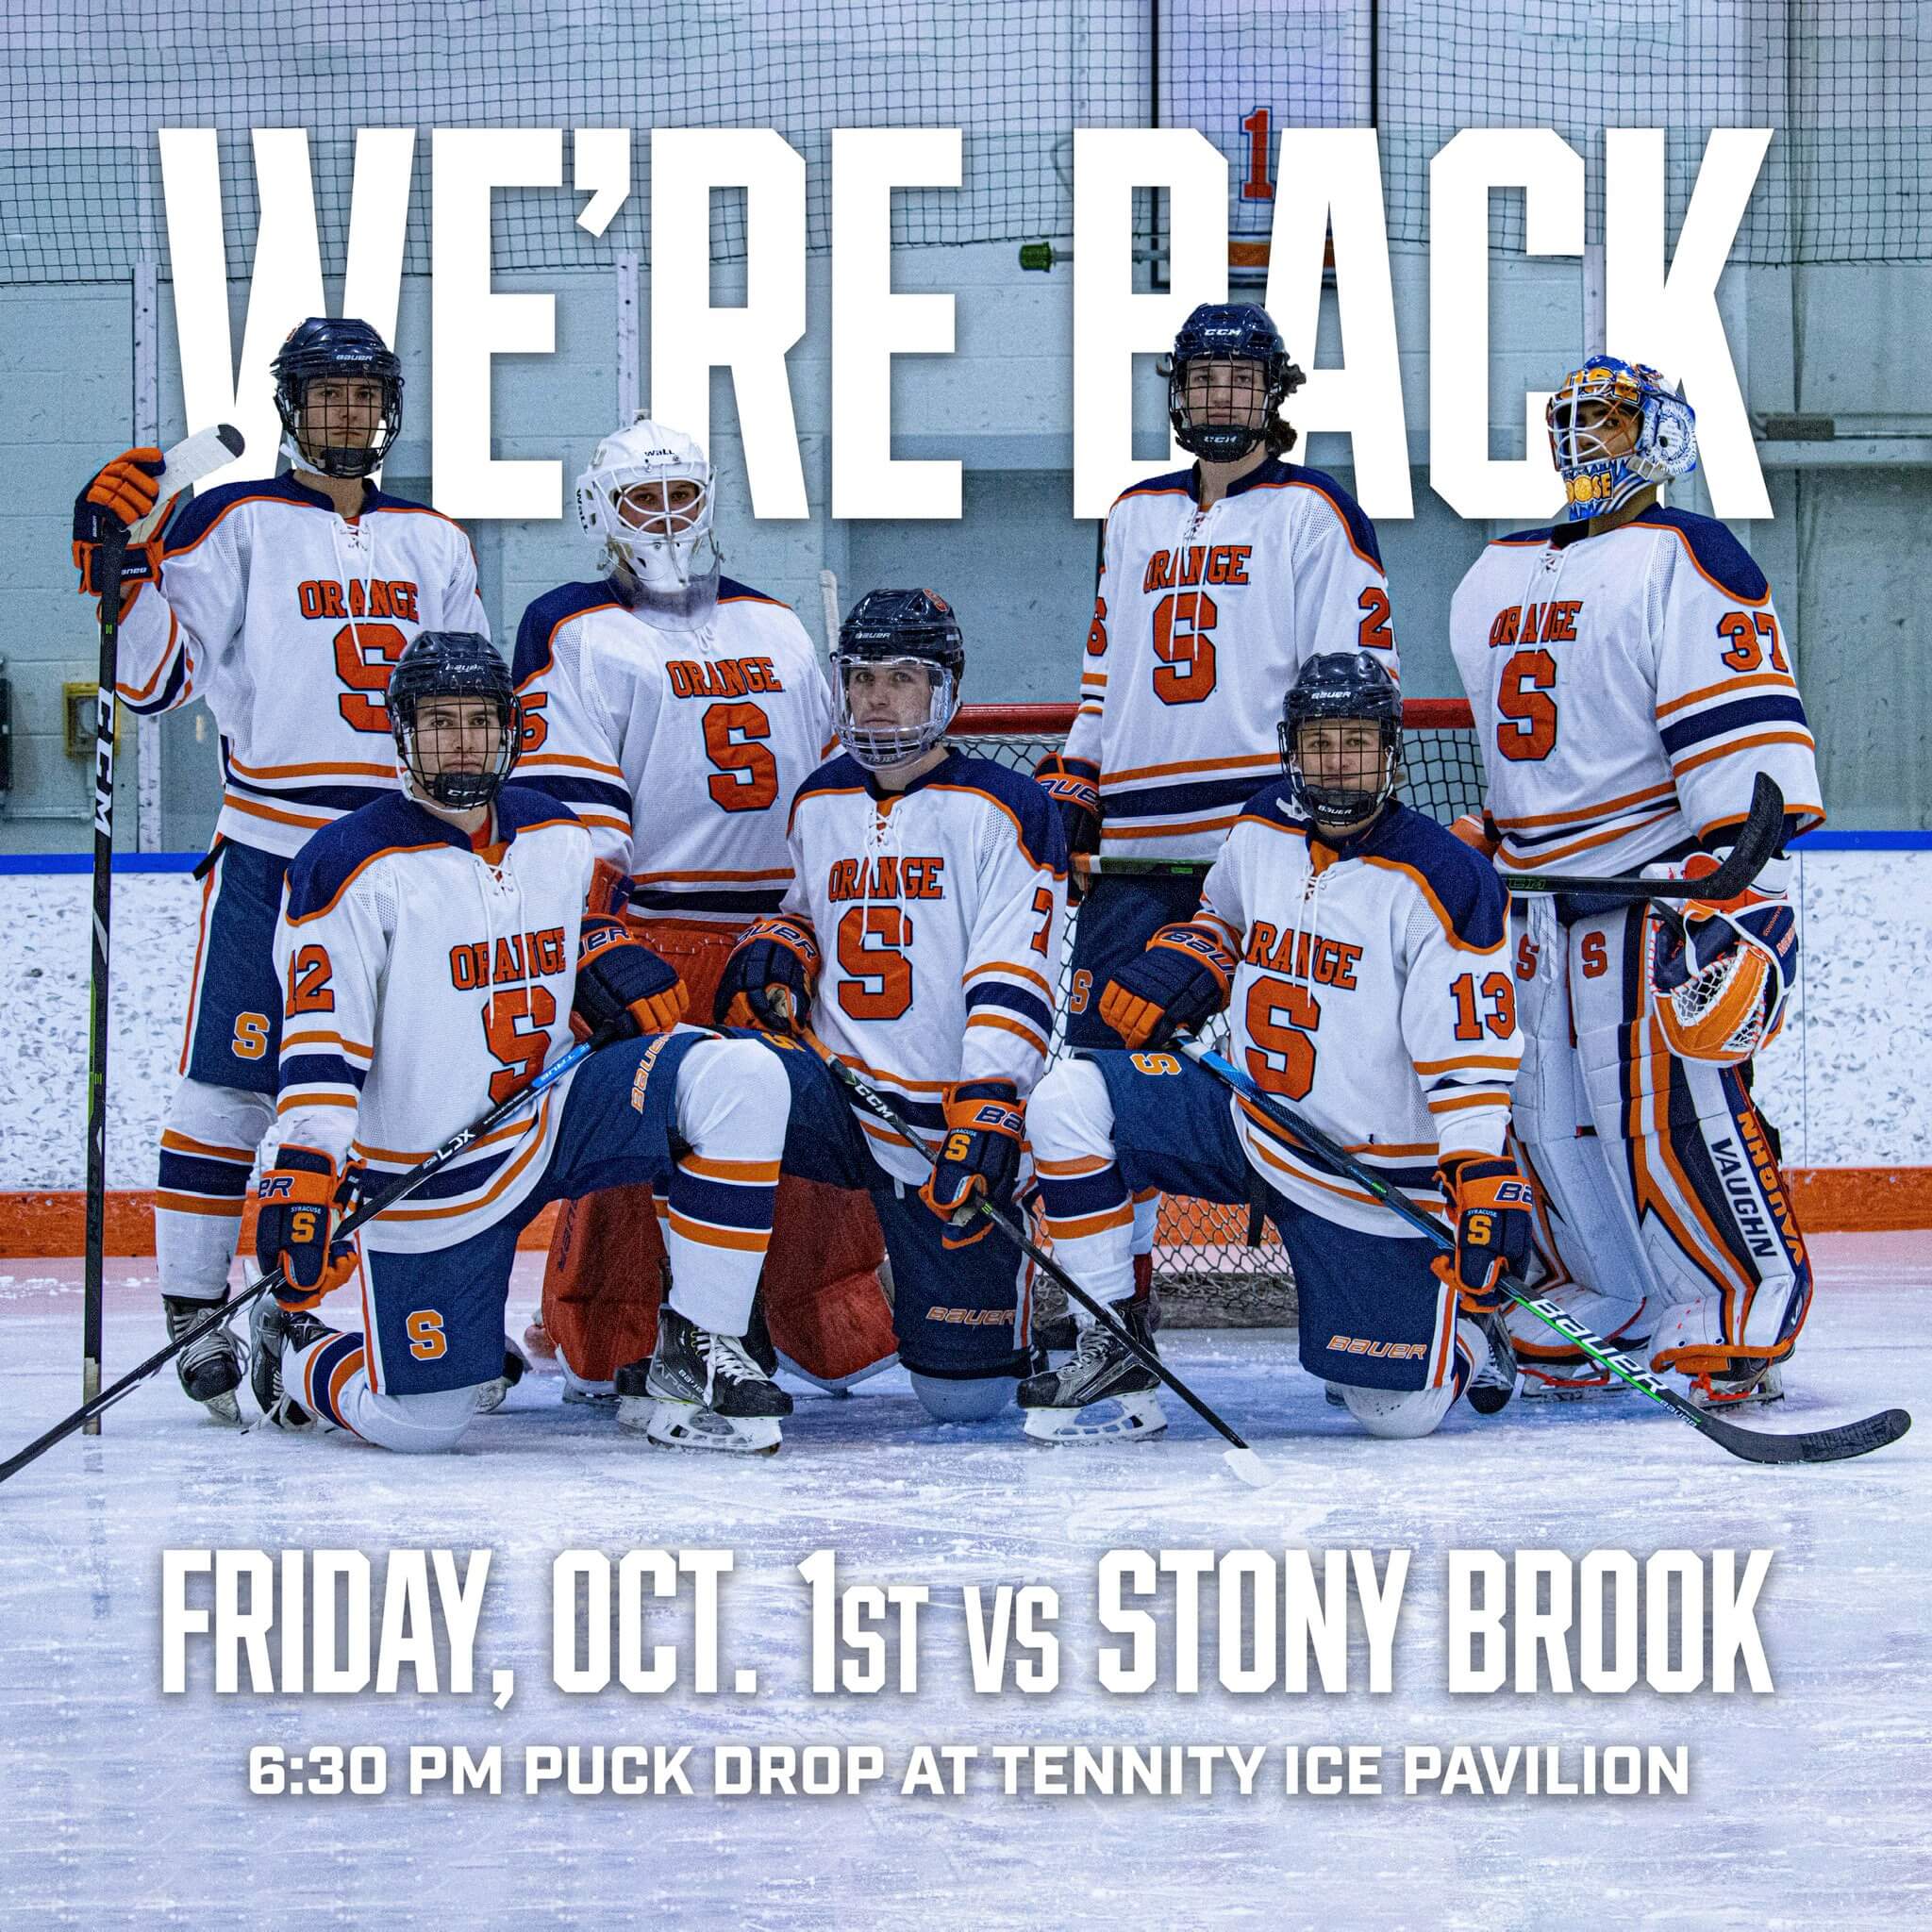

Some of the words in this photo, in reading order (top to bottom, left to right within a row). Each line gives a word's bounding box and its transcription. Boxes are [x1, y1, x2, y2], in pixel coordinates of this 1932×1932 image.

[1143, 545, 1253, 594] ORANGE
[297, 578, 420, 625] ORANGE
[1489, 600, 1584, 648] ORANGE
[1153, 591, 1218, 706] S
[1718, 611, 1789, 674] 37
[665, 656, 785, 698] ORANGE
[1497, 650, 1558, 761] S
[95, 687, 115, 839] CCM
[701, 702, 778, 813] S
[827, 856, 946, 904] ORANGE
[449, 925, 566, 991] ORANGE
[837, 905, 913, 1021] S
[1244, 919, 1363, 991] RANGE
[1581, 930, 1608, 979] S
[1069, 968, 1093, 1015] S
[1449, 972, 1517, 1041] 13
[231, 1010, 271, 1061] S
[1244, 974, 1320, 1103] S
[1129, 1053, 1182, 1075] S
[854, 1083, 894, 1119] CCM
[944, 1133, 972, 1162] S
[1710, 1138, 1778, 1257] VAUGHN
[291, 1211, 316, 1243] S
[1466, 1214, 1492, 1246] S
[406, 1309, 447, 1360] S
[925, 1306, 1016, 1325] BAUER
[1325, 1335, 1427, 1360] BAUER
[1529, 1298, 1670, 1394] BAUER
